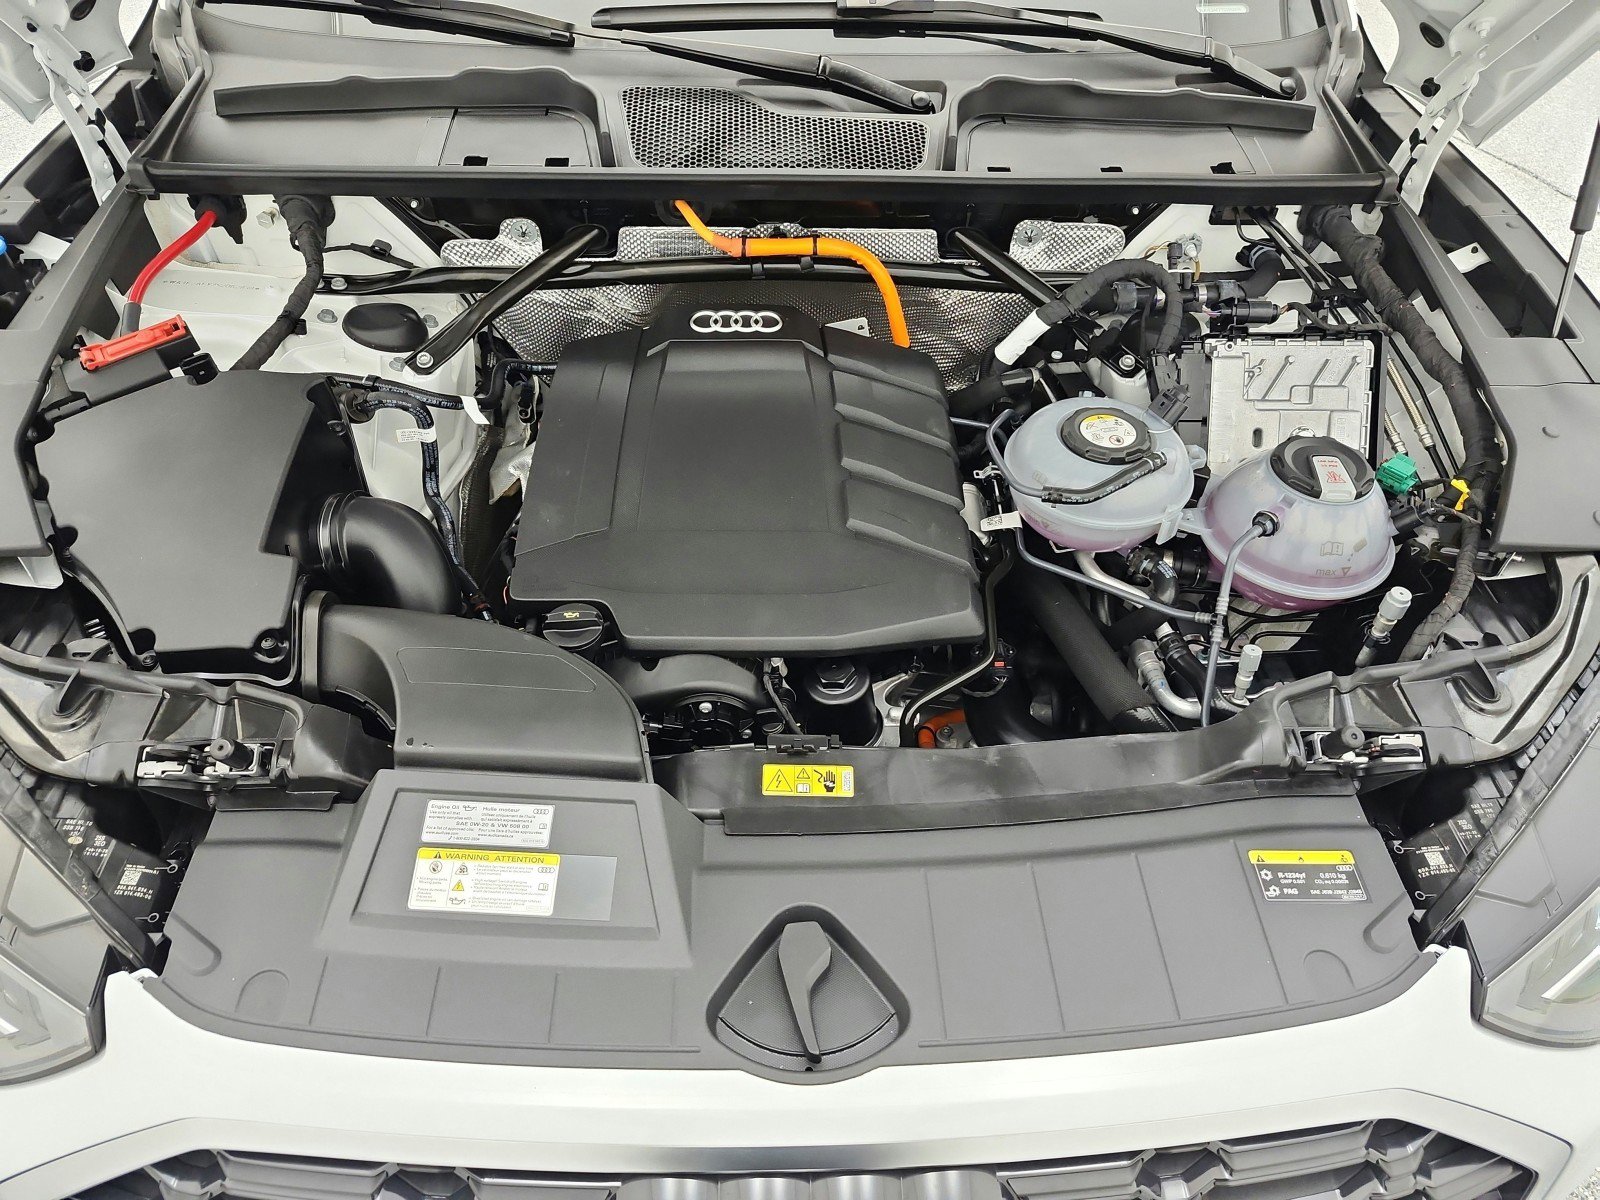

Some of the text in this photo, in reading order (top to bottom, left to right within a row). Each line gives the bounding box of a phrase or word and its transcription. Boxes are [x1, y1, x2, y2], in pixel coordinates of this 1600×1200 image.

[1315, 568, 1337, 576] max
[445, 853, 545, 864] WARNING ATTENTION
